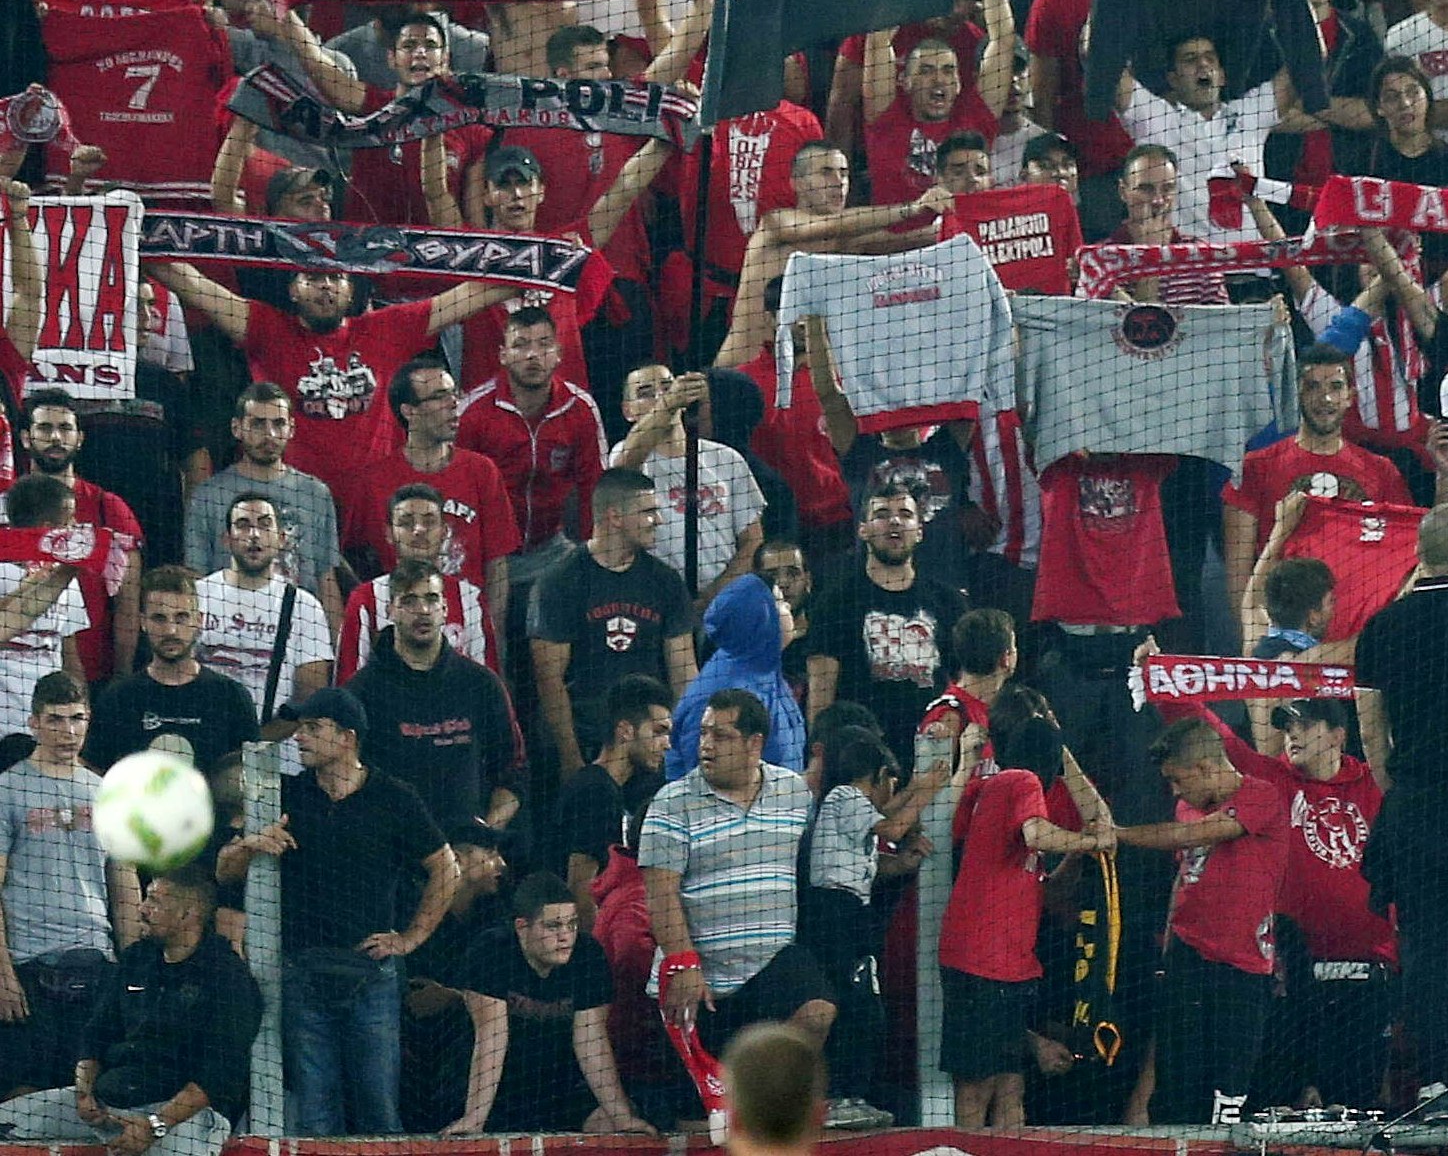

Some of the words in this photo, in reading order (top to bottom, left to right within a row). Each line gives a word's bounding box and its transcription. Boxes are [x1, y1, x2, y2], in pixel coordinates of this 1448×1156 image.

[124, 64, 162, 109] 7
[144, 217, 264, 255] ΑΡΤΗ
[1149, 661, 1303, 694] ΑΘΗΝΑ
